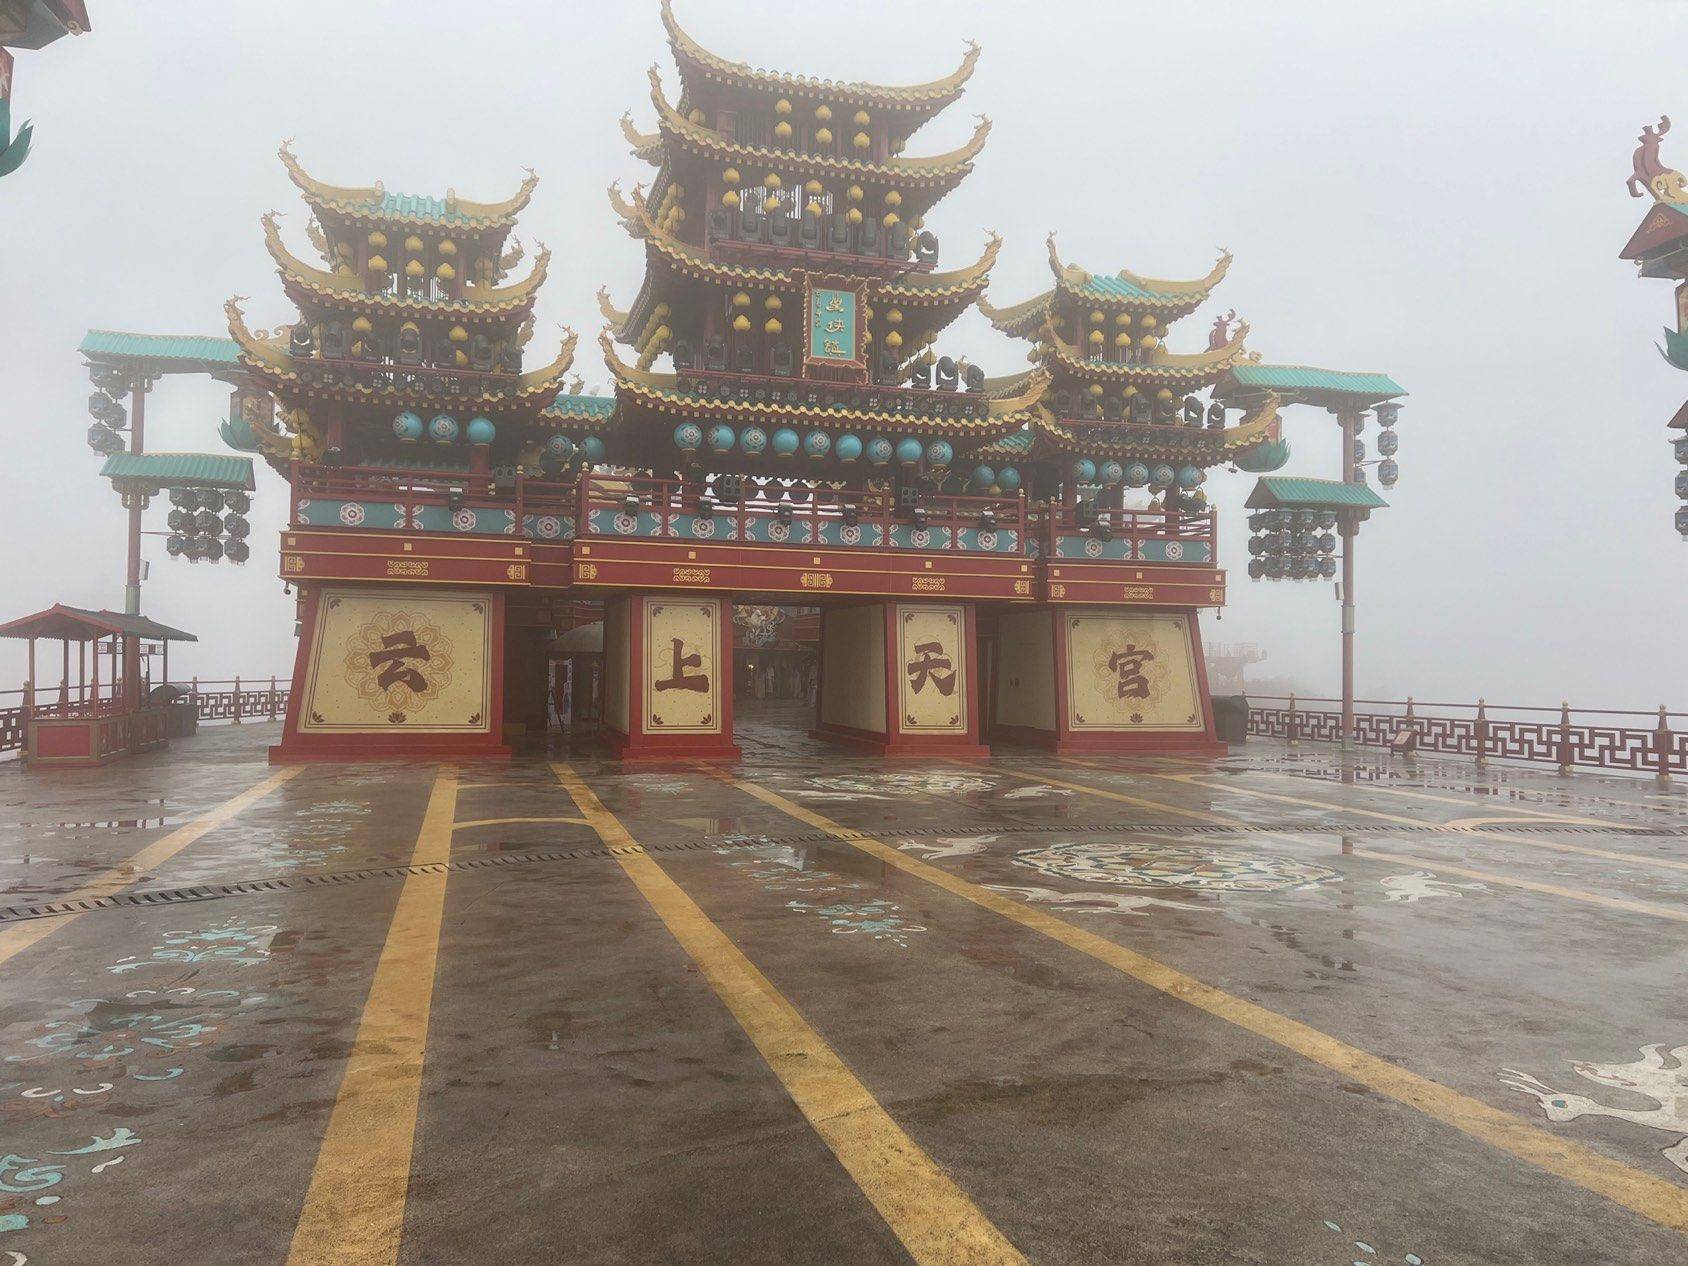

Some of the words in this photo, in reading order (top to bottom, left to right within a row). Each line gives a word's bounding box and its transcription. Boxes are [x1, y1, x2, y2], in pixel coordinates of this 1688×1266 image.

[369, 630, 431, 693] 云
[654, 637, 710, 693] 上
[907, 641, 957, 697] 天
[1108, 644, 1155, 700] 宫
